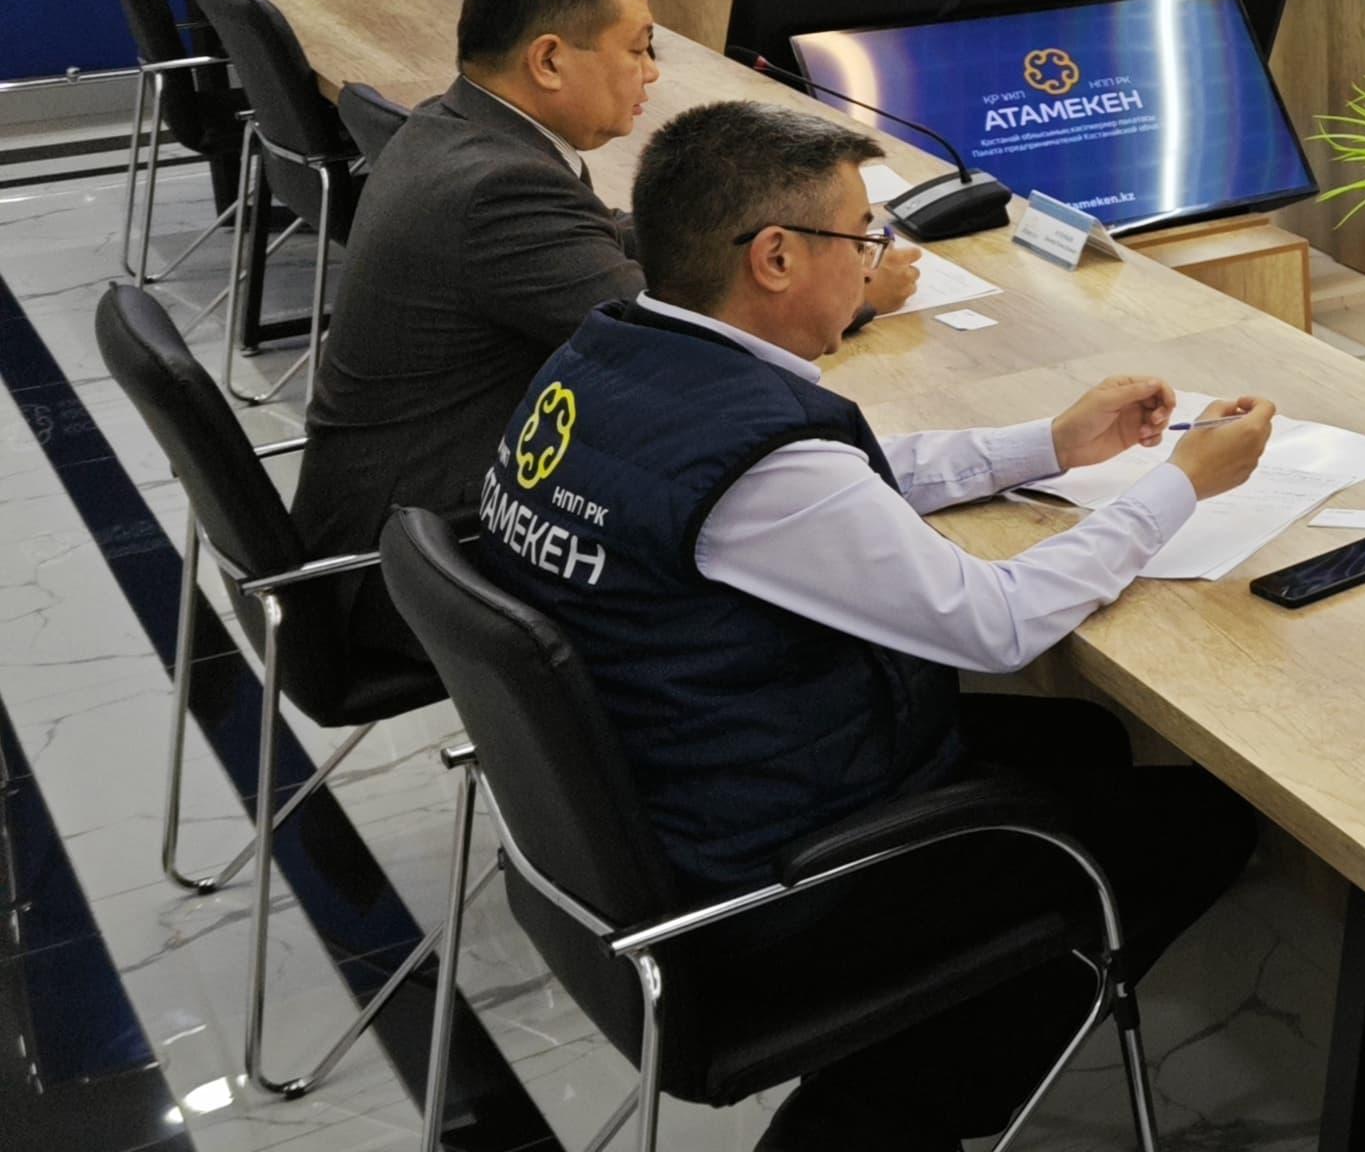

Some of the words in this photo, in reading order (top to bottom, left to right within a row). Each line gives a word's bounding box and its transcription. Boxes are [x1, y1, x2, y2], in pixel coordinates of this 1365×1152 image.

[984, 89, 1144, 132] АТАМЕКЕН
[480, 466, 606, 586] ТАМЕКЕН
[551, 486, 584, 515] НПП
[584, 501, 609, 527] РК
